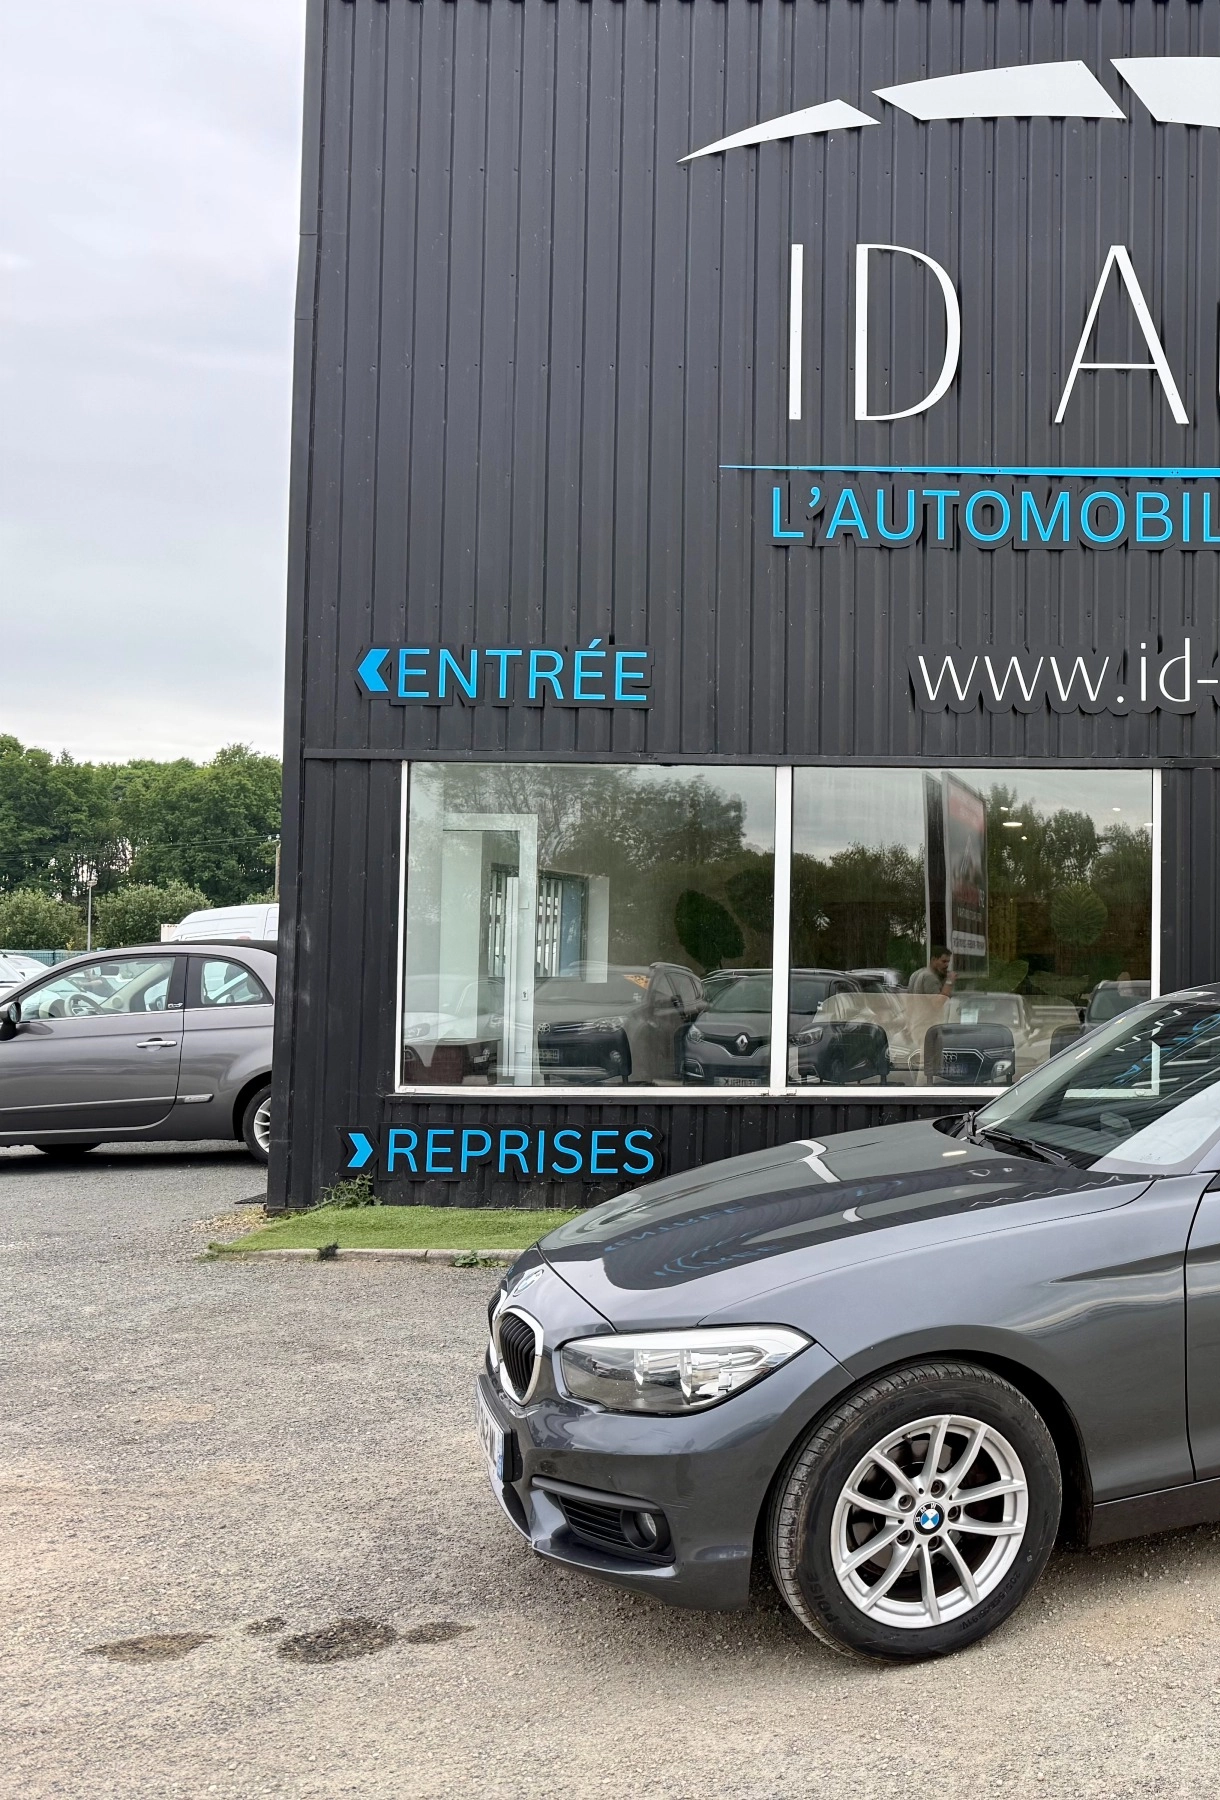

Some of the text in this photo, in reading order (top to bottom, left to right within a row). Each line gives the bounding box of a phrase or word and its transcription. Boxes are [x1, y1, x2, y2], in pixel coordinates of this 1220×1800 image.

[788, 243, 961, 421] ID
[396, 638, 648, 702] ENTRÉE
[387, 1128, 655, 1175] REPRISES
[806, 1571, 840, 1622] POISE
